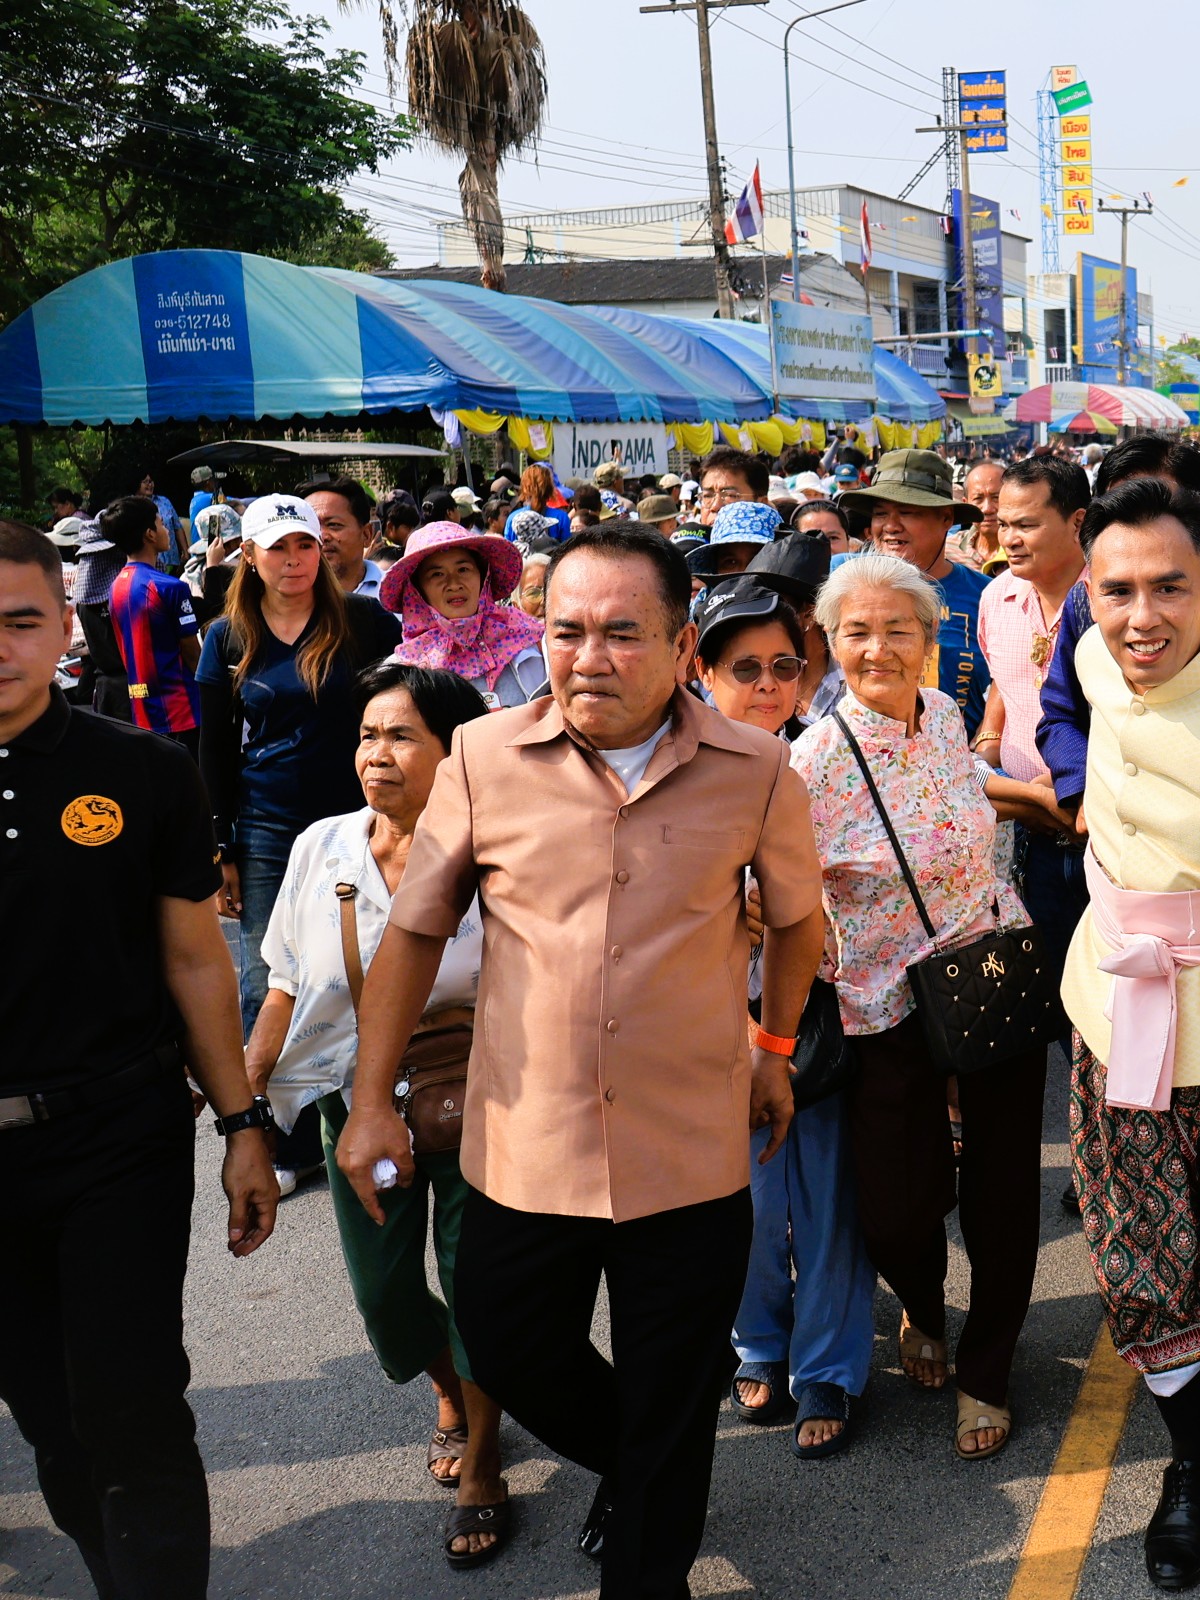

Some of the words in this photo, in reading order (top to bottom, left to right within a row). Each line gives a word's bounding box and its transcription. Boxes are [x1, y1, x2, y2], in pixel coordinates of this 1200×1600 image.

[960, 73, 1005, 97] โฉนดที่ดิน
[1062, 120, 1088, 134] เมือง
[1065, 145, 1087, 158] ไทย
[1068, 169, 1085, 182] สิน
[1066, 216, 1089, 230] ด่วน
[275, 504, 298, 516] M
[267, 515, 308, 524] BASKETBALL
